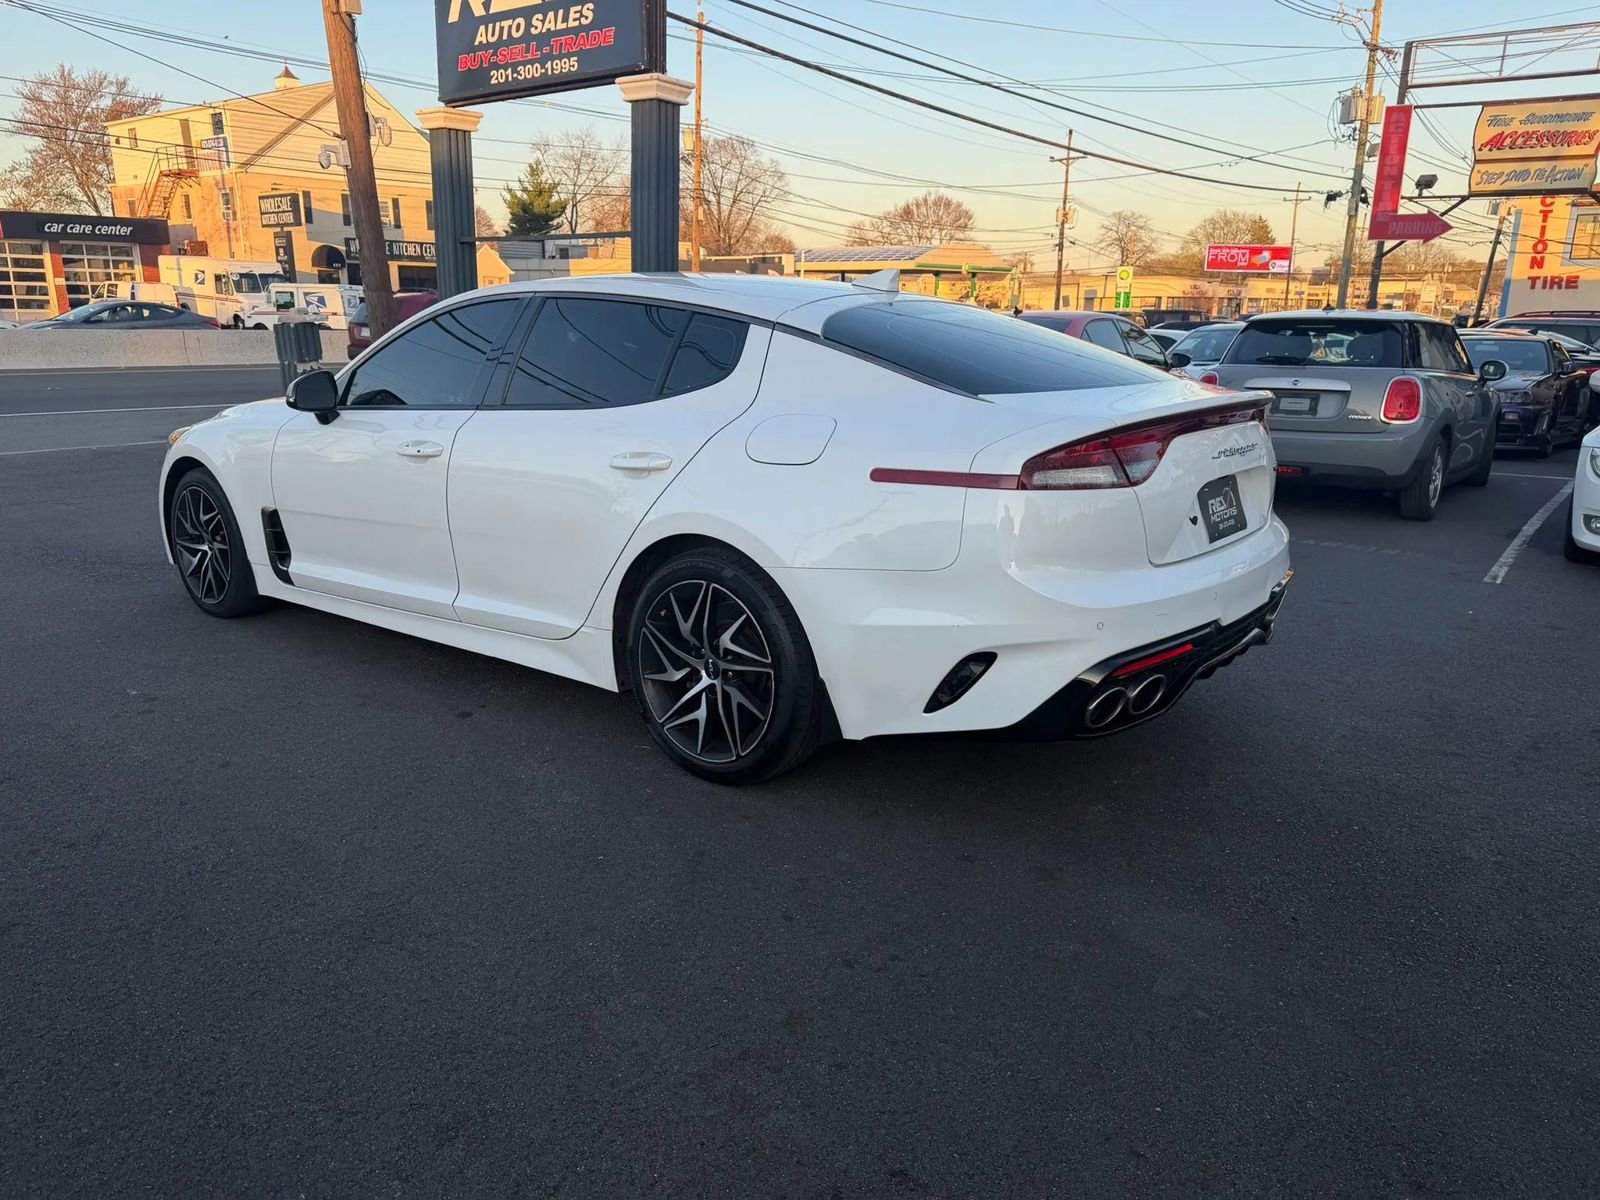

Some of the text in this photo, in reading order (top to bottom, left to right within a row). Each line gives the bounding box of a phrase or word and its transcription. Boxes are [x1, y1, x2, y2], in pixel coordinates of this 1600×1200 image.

[474, 17, 526, 46] AUTO
[530, 3, 595, 36] SALES
[551, 27, 616, 56] TRADE
[490, 56, 578, 85] 201-300-1995
[1478, 129, 1600, 152] ACCESSORIES
[259, 196, 292, 213] WHOLESALE
[44, 222, 133, 236] car care center
[392, 242, 421, 256] KITCHEN
[1208, 251, 1249, 263] FROM
[1527, 274, 1580, 290] TIRE
[1210, 506, 1238, 523] MOTORS
